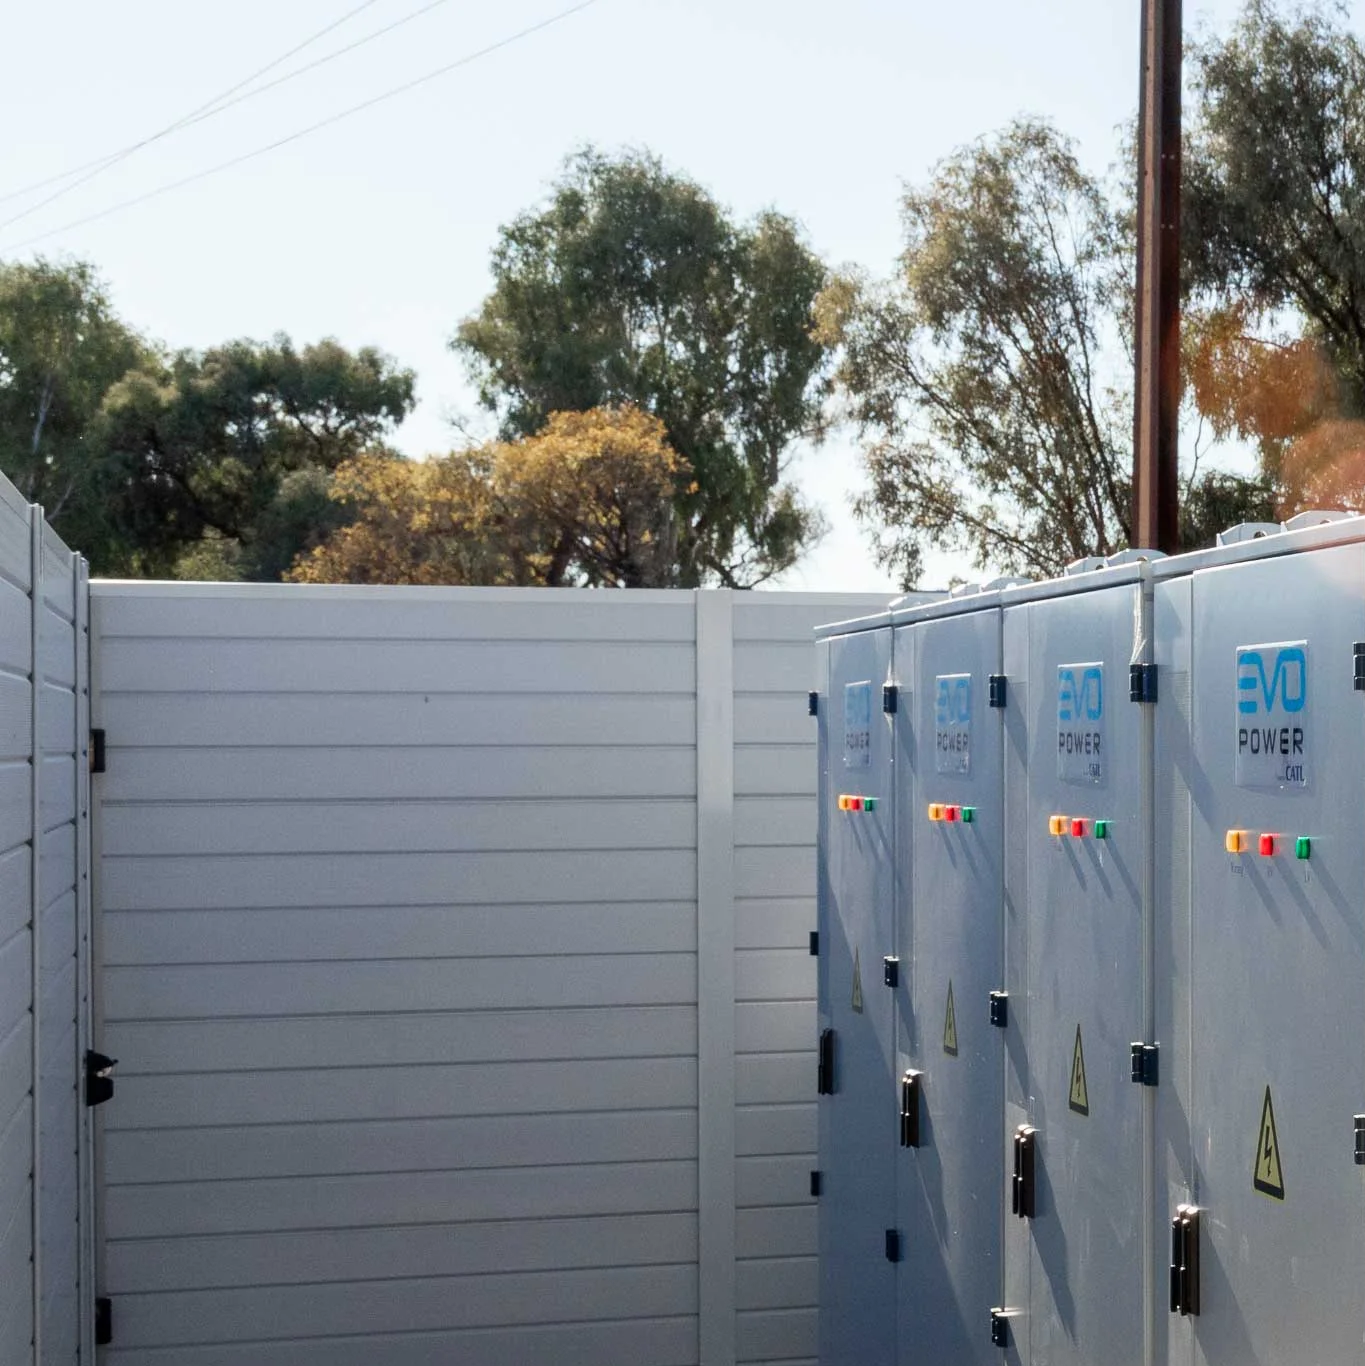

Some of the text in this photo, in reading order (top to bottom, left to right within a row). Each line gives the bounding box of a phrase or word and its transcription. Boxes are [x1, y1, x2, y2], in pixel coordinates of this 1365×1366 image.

[1238, 648, 1306, 714] EVO
[1058, 668, 1102, 721] EVO
[937, 732, 969, 752] POWER
[1058, 732, 1101, 755] POWER
[1239, 728, 1304, 755] POWER
[1285, 765, 1305, 781] CATL
